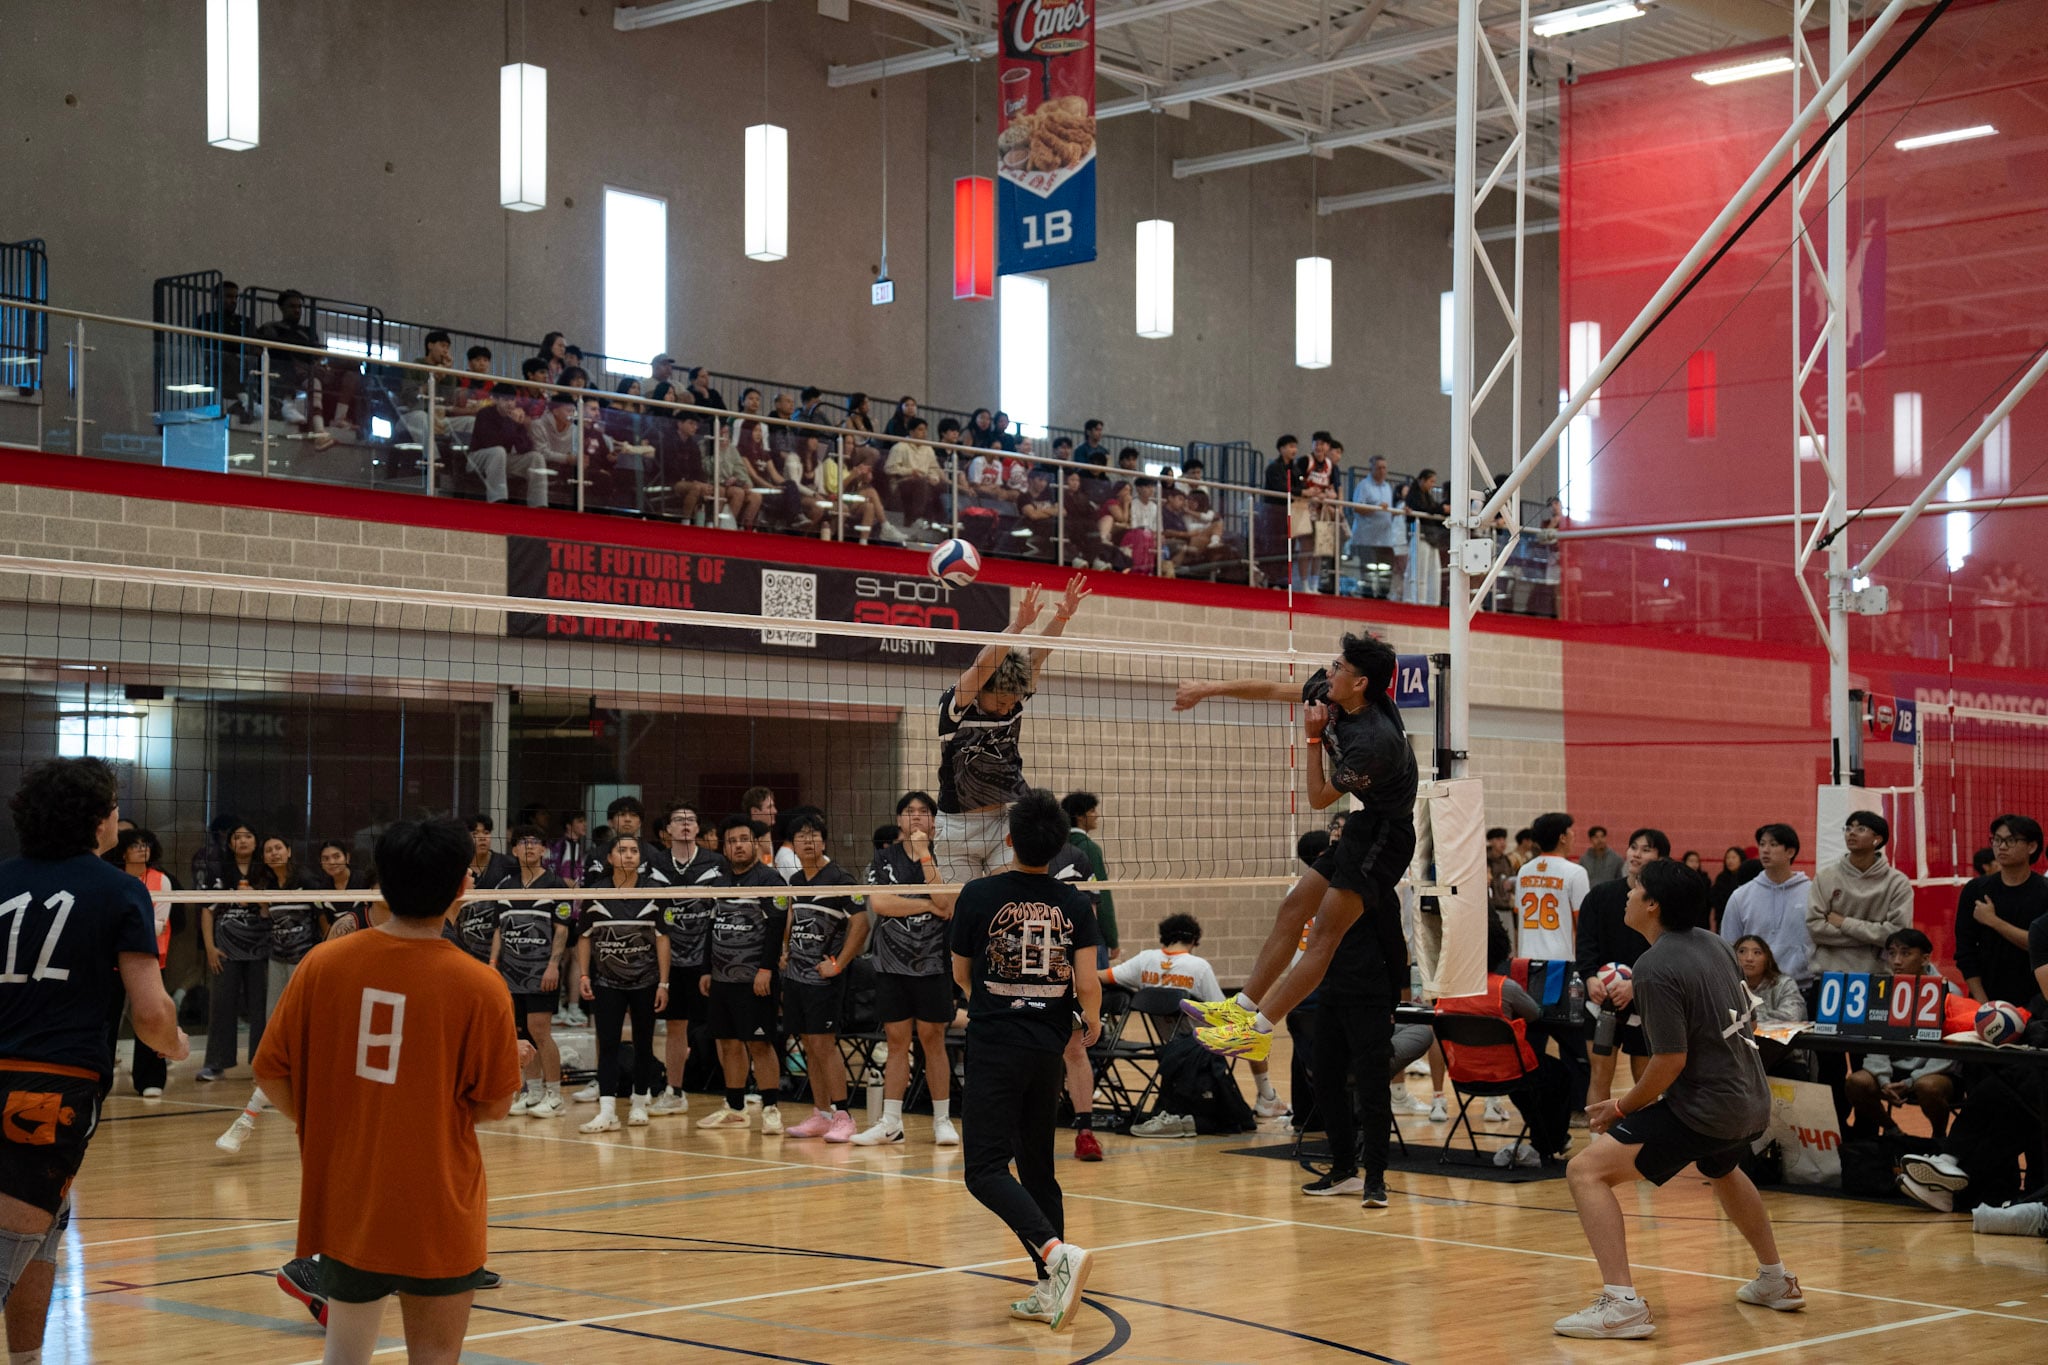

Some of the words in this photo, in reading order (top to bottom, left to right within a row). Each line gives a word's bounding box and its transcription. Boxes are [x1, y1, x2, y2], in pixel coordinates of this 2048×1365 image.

[1023, 209, 1073, 249] 1B
[547, 542, 595, 572] THE
[601, 548, 691, 581] FUTURE
[697, 557, 726, 584] OF
[547, 571, 695, 609] BASKETBALL
[855, 577, 949, 603] SHOOT
[547, 614, 579, 634] IS
[854, 600, 960, 630] 360
[880, 638, 935, 655] AUSTIN
[1402, 667, 1424, 693] 1A
[1898, 709, 1912, 732] 1B
[1521, 892, 1560, 930] 26
[504, 937, 547, 945] NTONIO
[1821, 979, 1866, 1018] 03
[1877, 980, 1886, 998] 1
[1892, 981, 1939, 1020] 02
[356, 987, 406, 1084] 8
[1816, 1025, 1833, 1033] HOME
